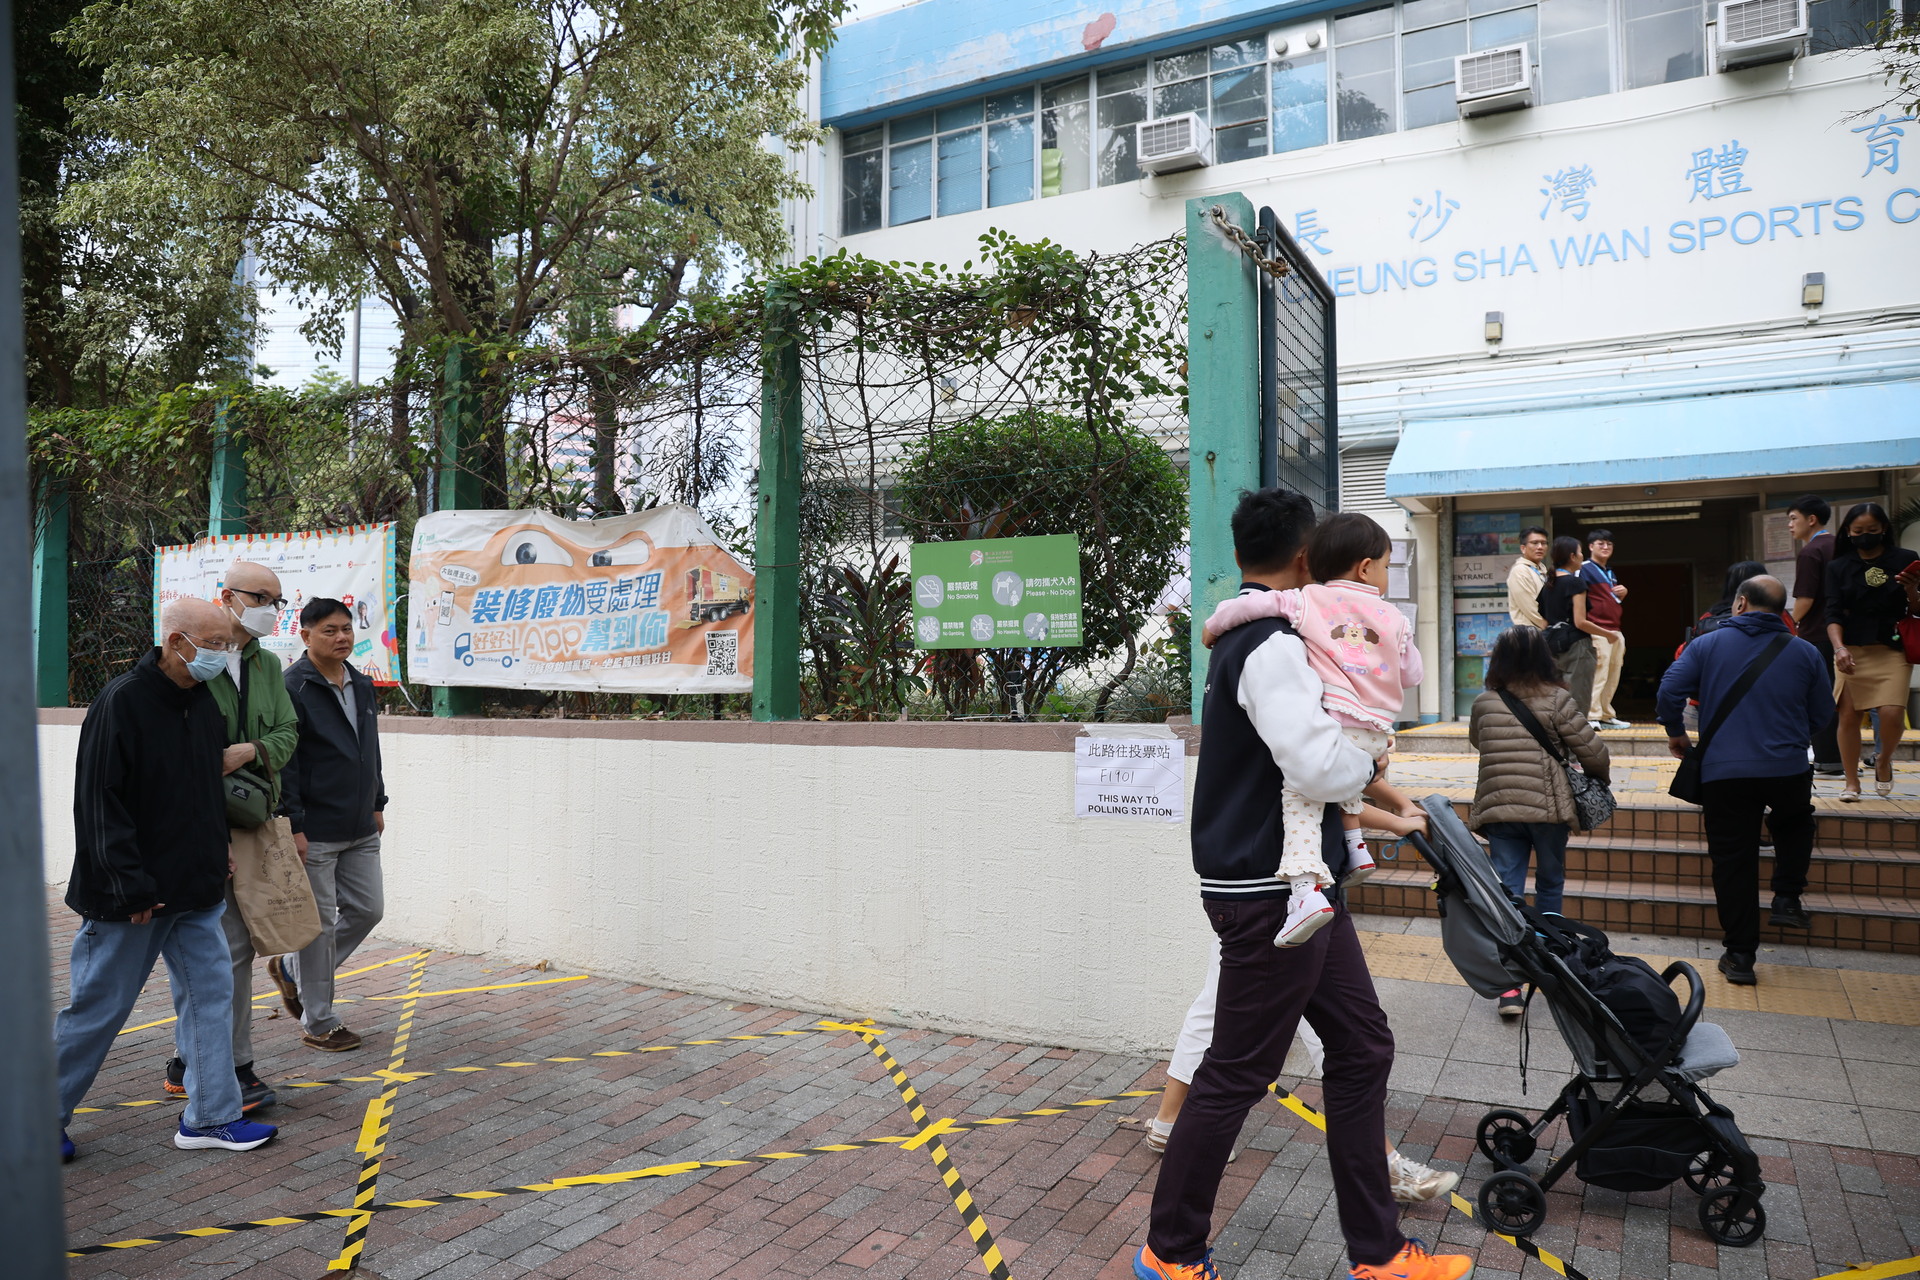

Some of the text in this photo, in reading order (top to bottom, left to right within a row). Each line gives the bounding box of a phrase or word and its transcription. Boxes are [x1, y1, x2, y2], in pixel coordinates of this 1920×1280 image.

[1454, 244, 1537, 280] SHA
[1550, 227, 1650, 268] WAN
[1668, 196, 1866, 254] SPORTS
[1464, 562, 1483, 572] 入口
[1453, 572, 1494, 582] ENTRANCE
[472, 572, 662, 624] 裝修廢物要處理
[956, 593, 979, 601] Smoking
[1060, 588, 1076, 597] Dogs
[522, 624, 583, 660] App
[1088, 743, 1170, 760] 此路往投票站
[1098, 794, 1159, 805] THIS WAY TO
[1088, 804, 1172, 817] POLLING STATION
